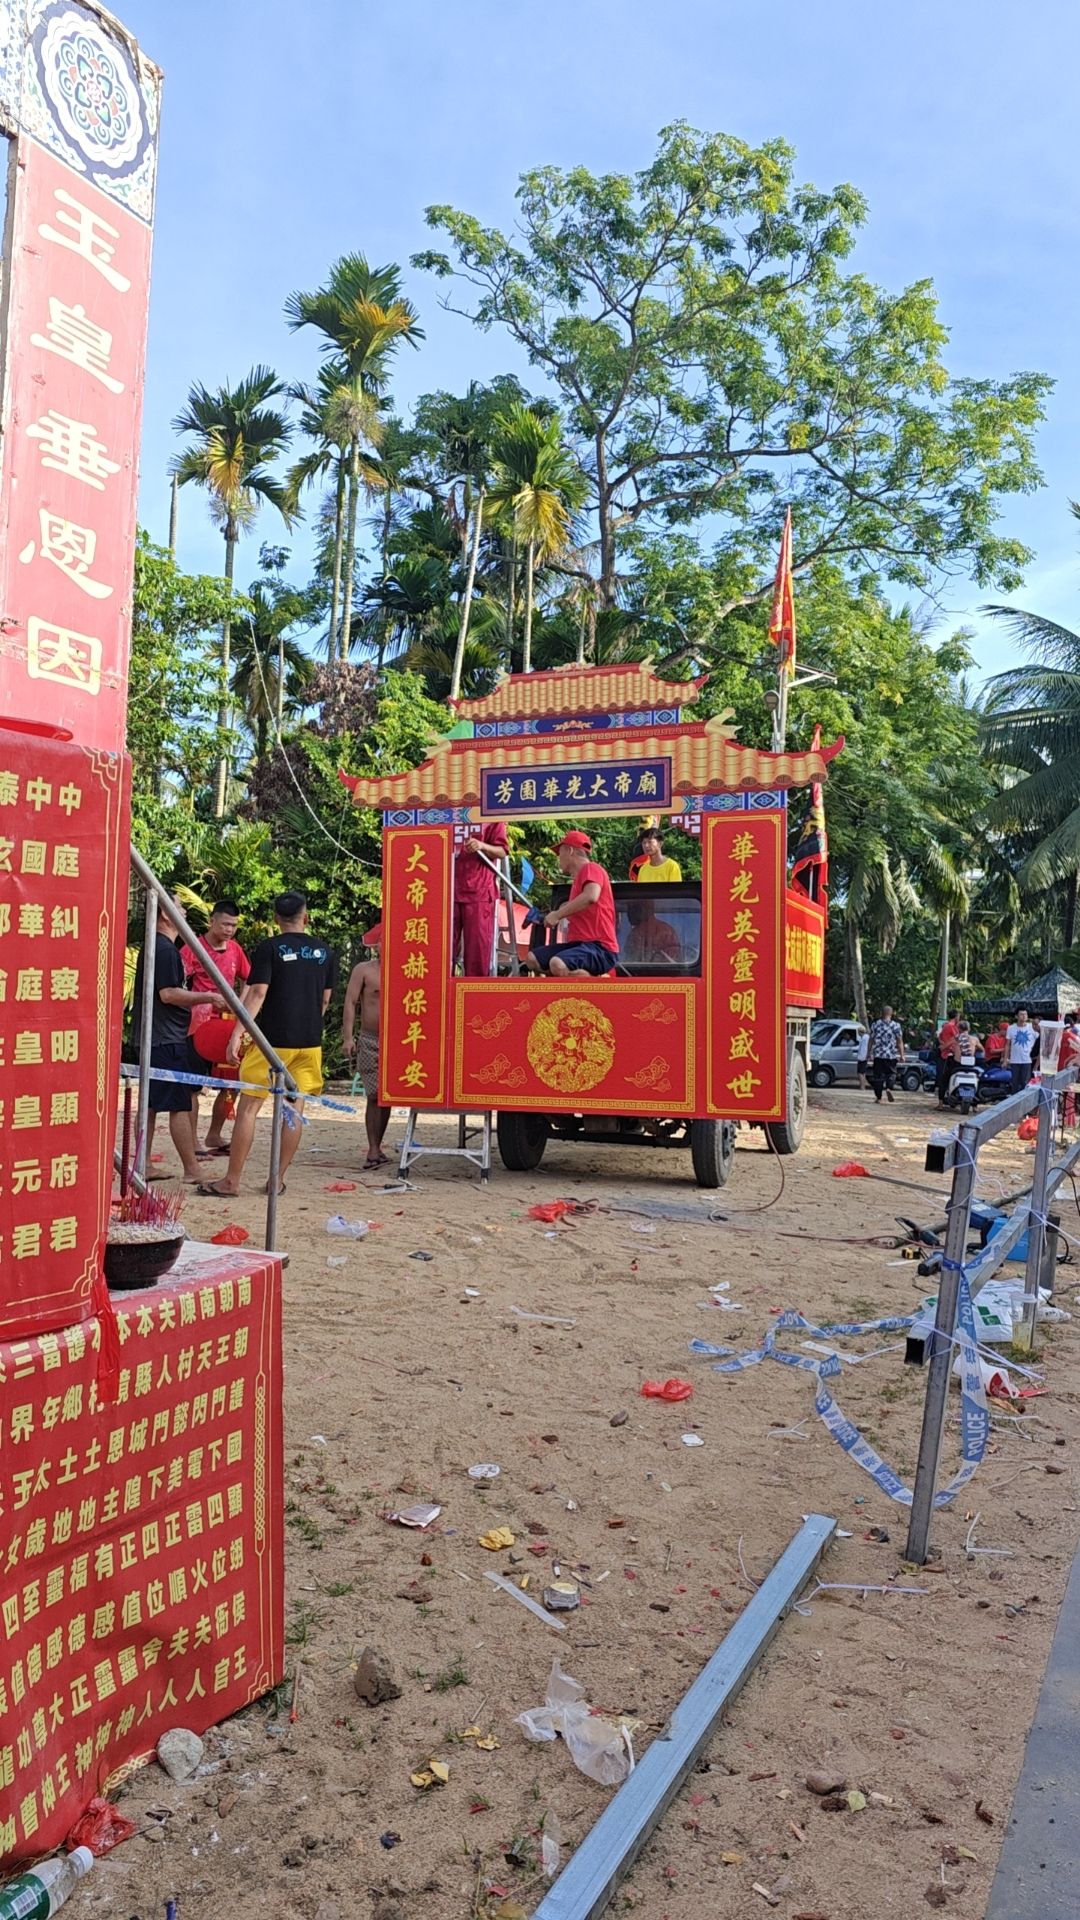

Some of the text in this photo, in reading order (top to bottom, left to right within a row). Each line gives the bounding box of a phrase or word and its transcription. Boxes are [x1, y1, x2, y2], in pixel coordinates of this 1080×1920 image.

[19, 188, 131, 696] 玉皇垂恩因
[49, 782, 82, 1252] 中庭糾察明顯府君
[399, 844, 429, 1088] 大帝顯赫保平安
[726, 831, 761, 1099] 華光英靈明盛世
[967, 1412, 985, 1458] POLICE
